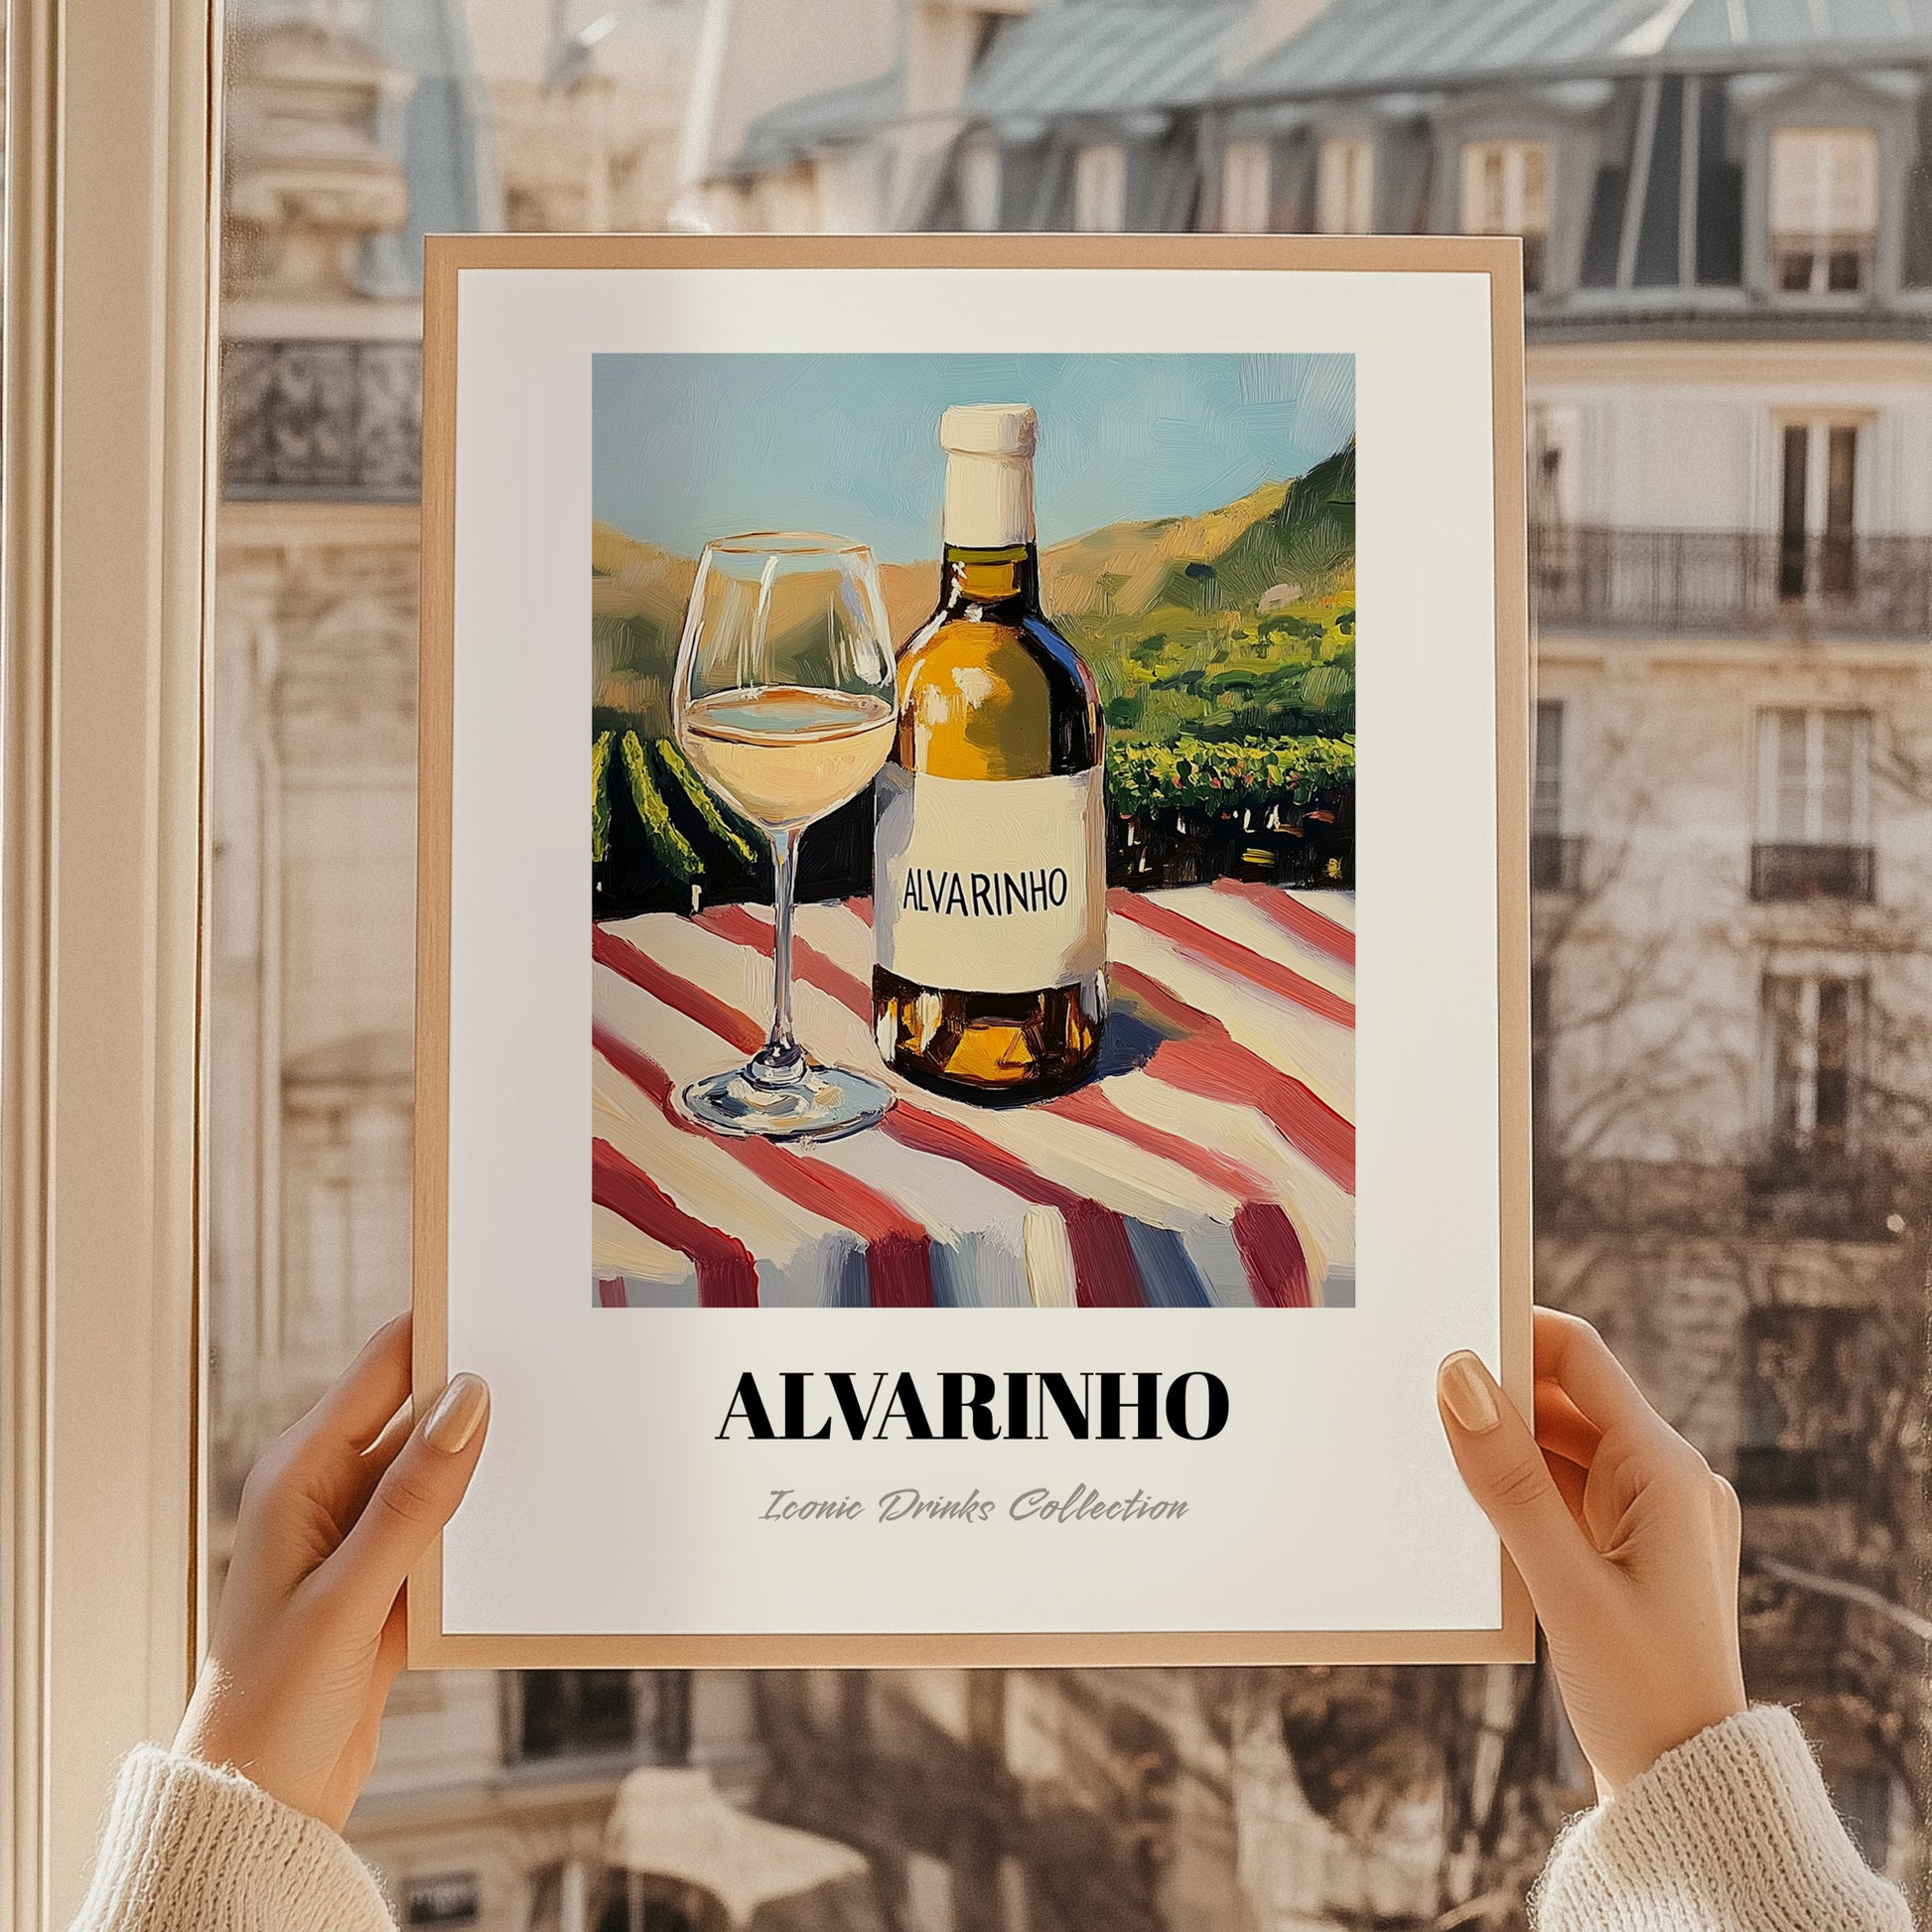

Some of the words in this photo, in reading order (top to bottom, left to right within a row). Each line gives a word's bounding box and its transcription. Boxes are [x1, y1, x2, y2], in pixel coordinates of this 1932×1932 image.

[902, 867, 1068, 917] ALVARINHO
[714, 1371, 1230, 1442] ALVARINHO
[758, 1488, 866, 1524] Iconic
[878, 1487, 997, 1524] Drinks
[1009, 1481, 1191, 1524] Collection
